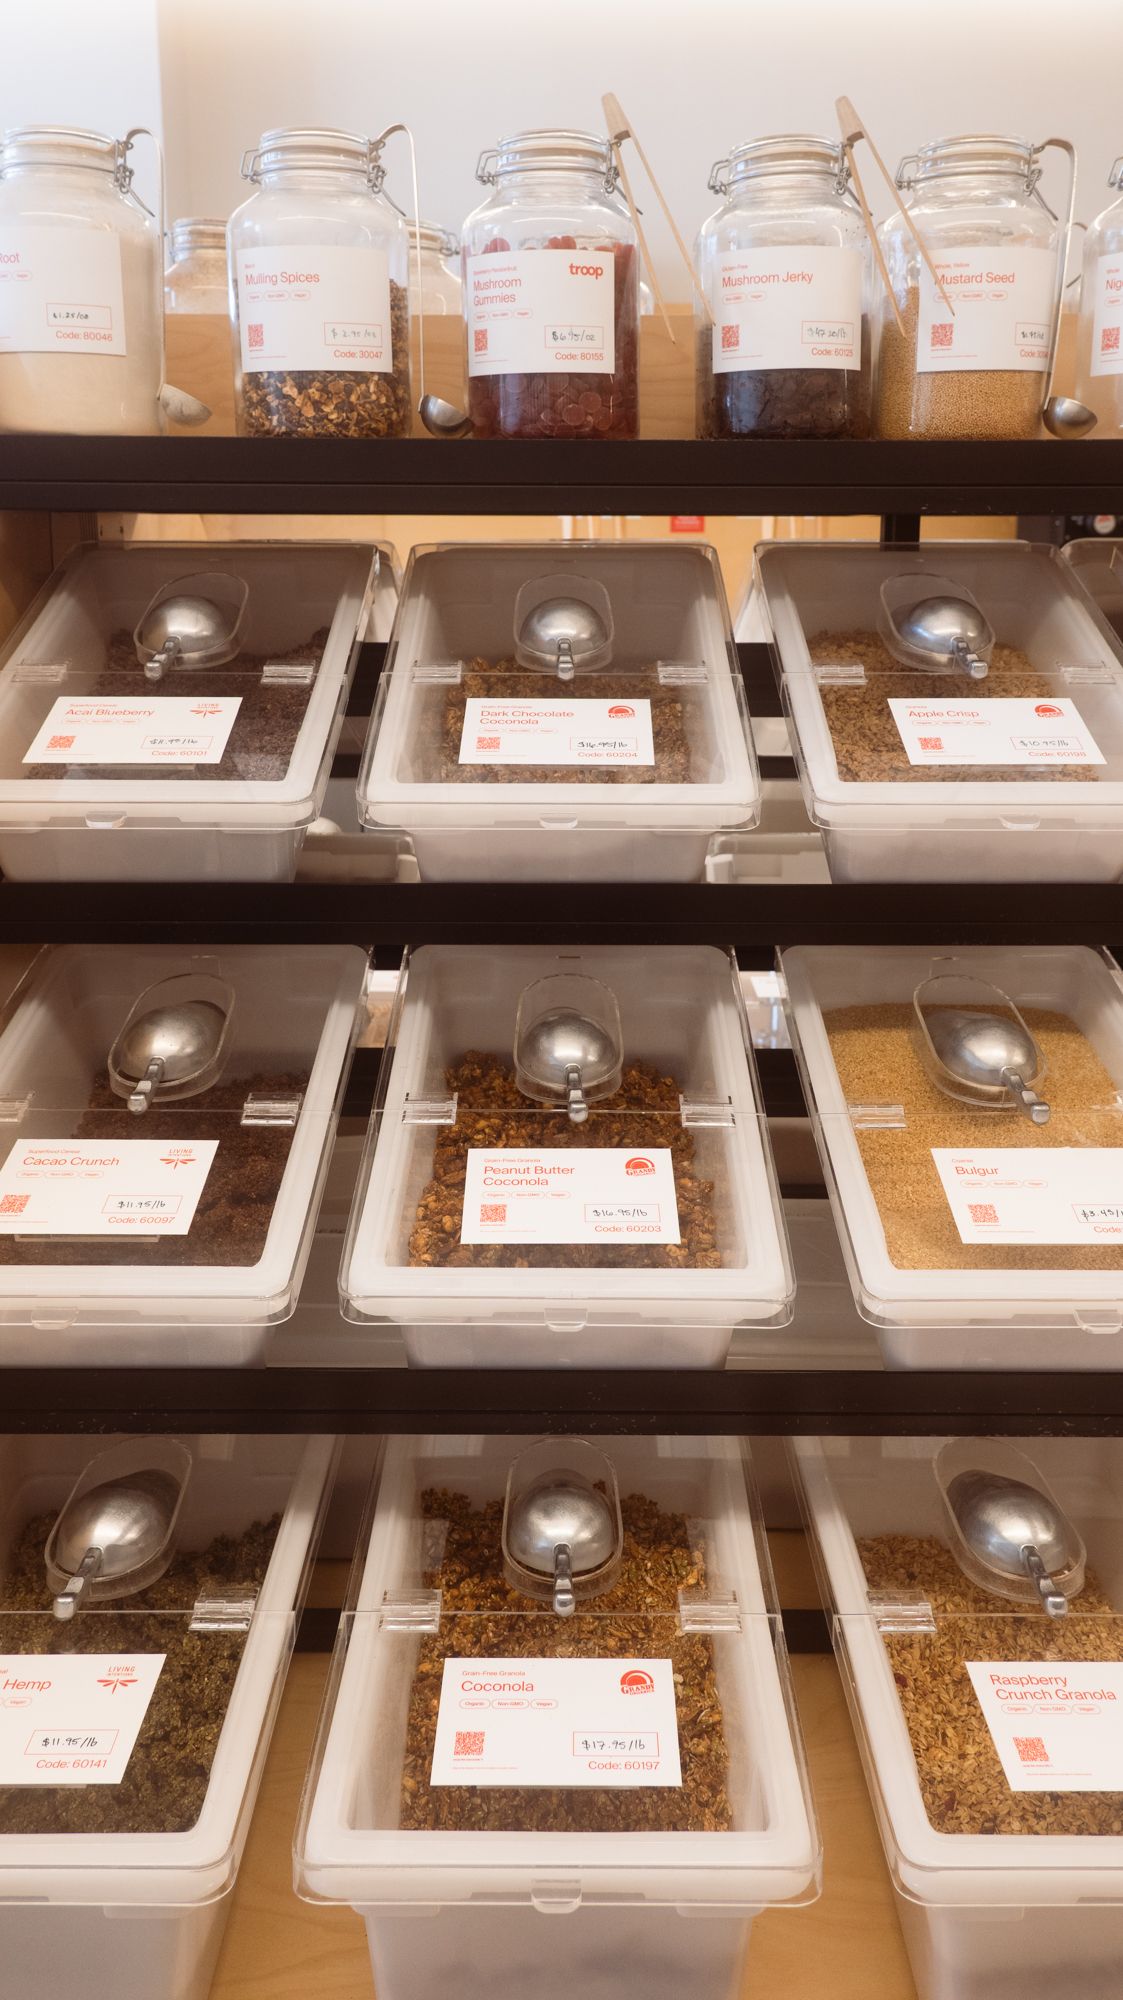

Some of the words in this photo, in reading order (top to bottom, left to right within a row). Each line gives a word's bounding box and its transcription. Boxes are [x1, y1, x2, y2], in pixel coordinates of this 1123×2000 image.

[570, 263, 603, 280] troop
[246, 274, 278, 285] Mulling
[280, 272, 320, 284] Spices
[722, 274, 780, 288] Mushroom
[782, 272, 813, 284] Jerky
[935, 273, 982, 286] Mustard
[986, 272, 1014, 284] Seed
[474, 277, 521, 292] Mushroom
[474, 293, 516, 306] Gummies
[56, 331, 82, 340] Code:
[84, 332, 112, 342] 80046
[334, 350, 357, 358] Code:
[360, 350, 382, 358] 30047
[555, 352, 578, 360] Code:
[580, 352, 604, 360] 80155
[24, 1157, 66, 1166] Cacao
[70, 1157, 119, 1166] Crunch
[484, 1166, 532, 1174] Peanut
[534, 1166, 574, 1174] Butter
[956, 1166, 999, 1176] Bulgur
[484, 1177, 548, 1186] Coconola
[3, 1679, 51, 1692] Hemp
[461, 1680, 534, 1692] Coconola
[990, 1674, 1067, 1687] Raspberry
[996, 1689, 1052, 1700] Crunch
[1055, 1689, 1116, 1700] Granola
[36, 1760, 70, 1768] Code:
[72, 1760, 108, 1768] 60141
[588, 1761, 622, 1770] Code:
[624, 1761, 660, 1770] 60197
